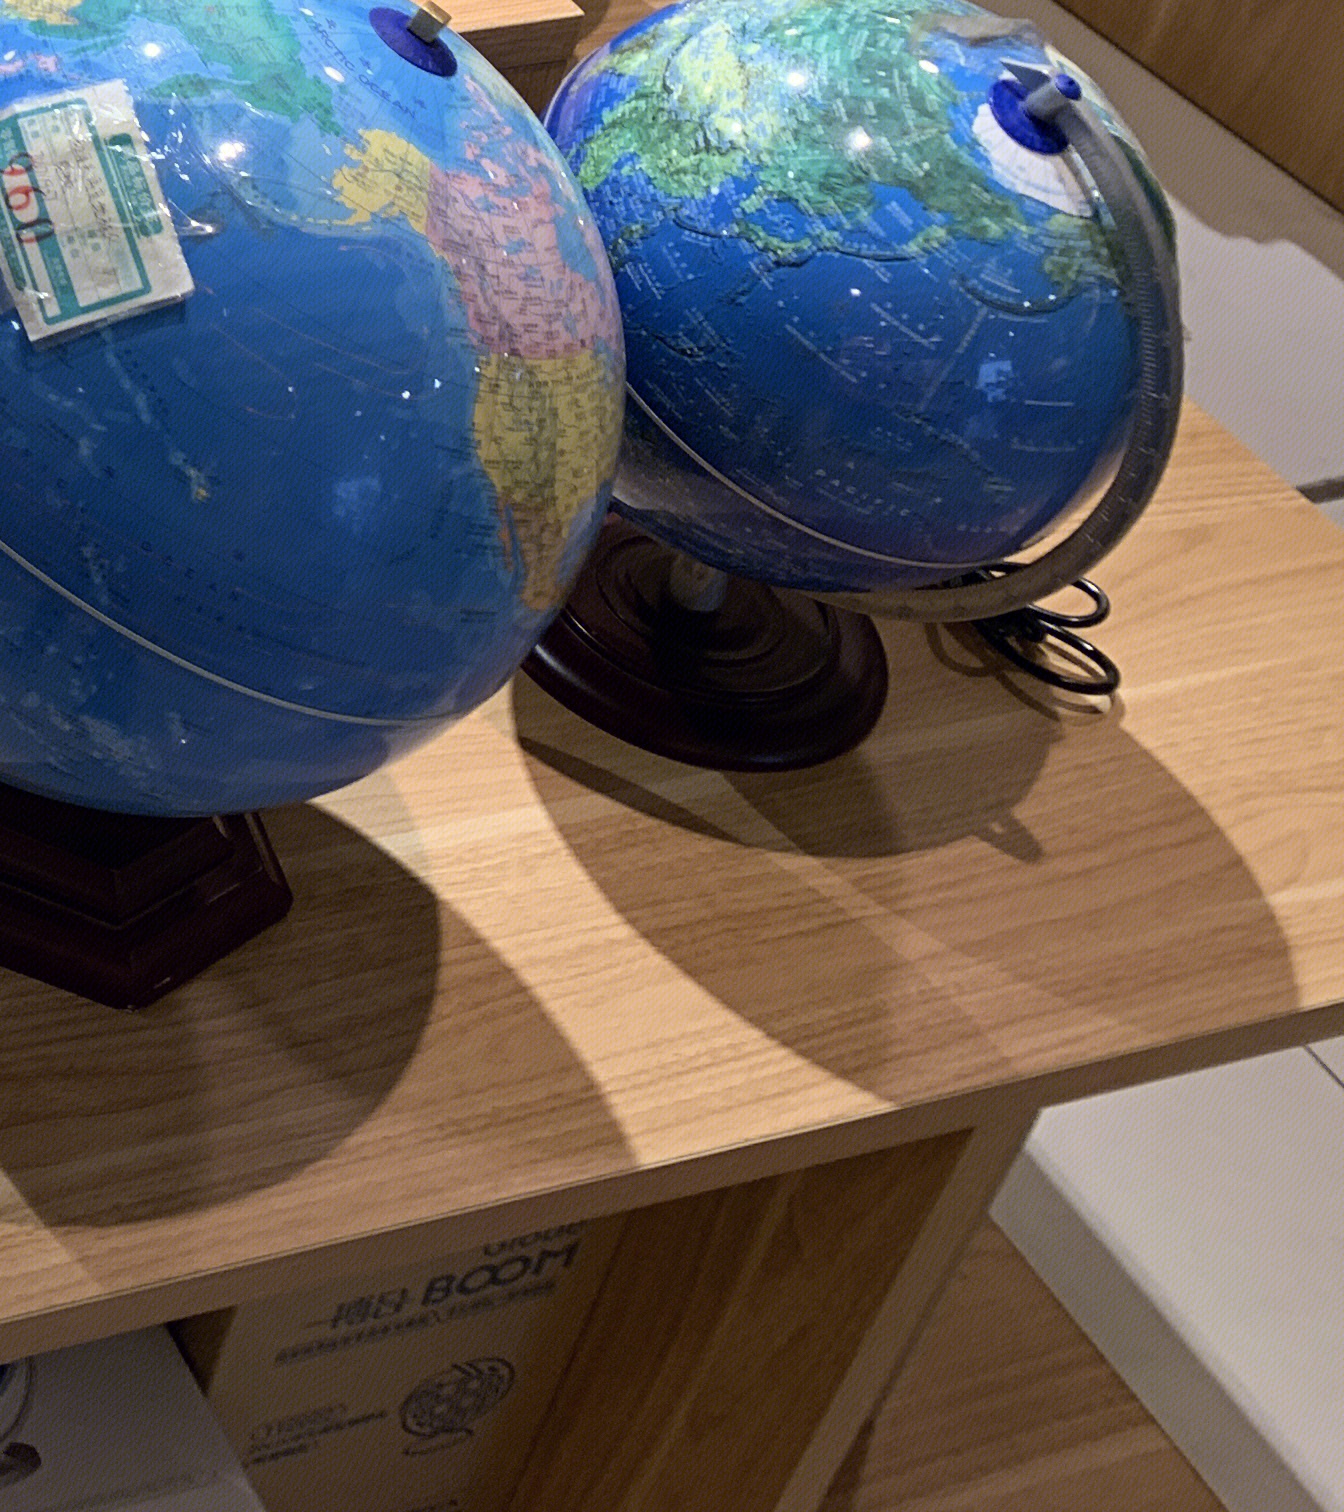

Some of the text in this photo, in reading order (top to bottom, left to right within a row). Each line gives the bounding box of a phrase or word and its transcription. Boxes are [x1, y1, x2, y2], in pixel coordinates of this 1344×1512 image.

[311, 20, 417, 120] ARCTIC OCEAN
[420, 1242, 581, 1307] BOOM
